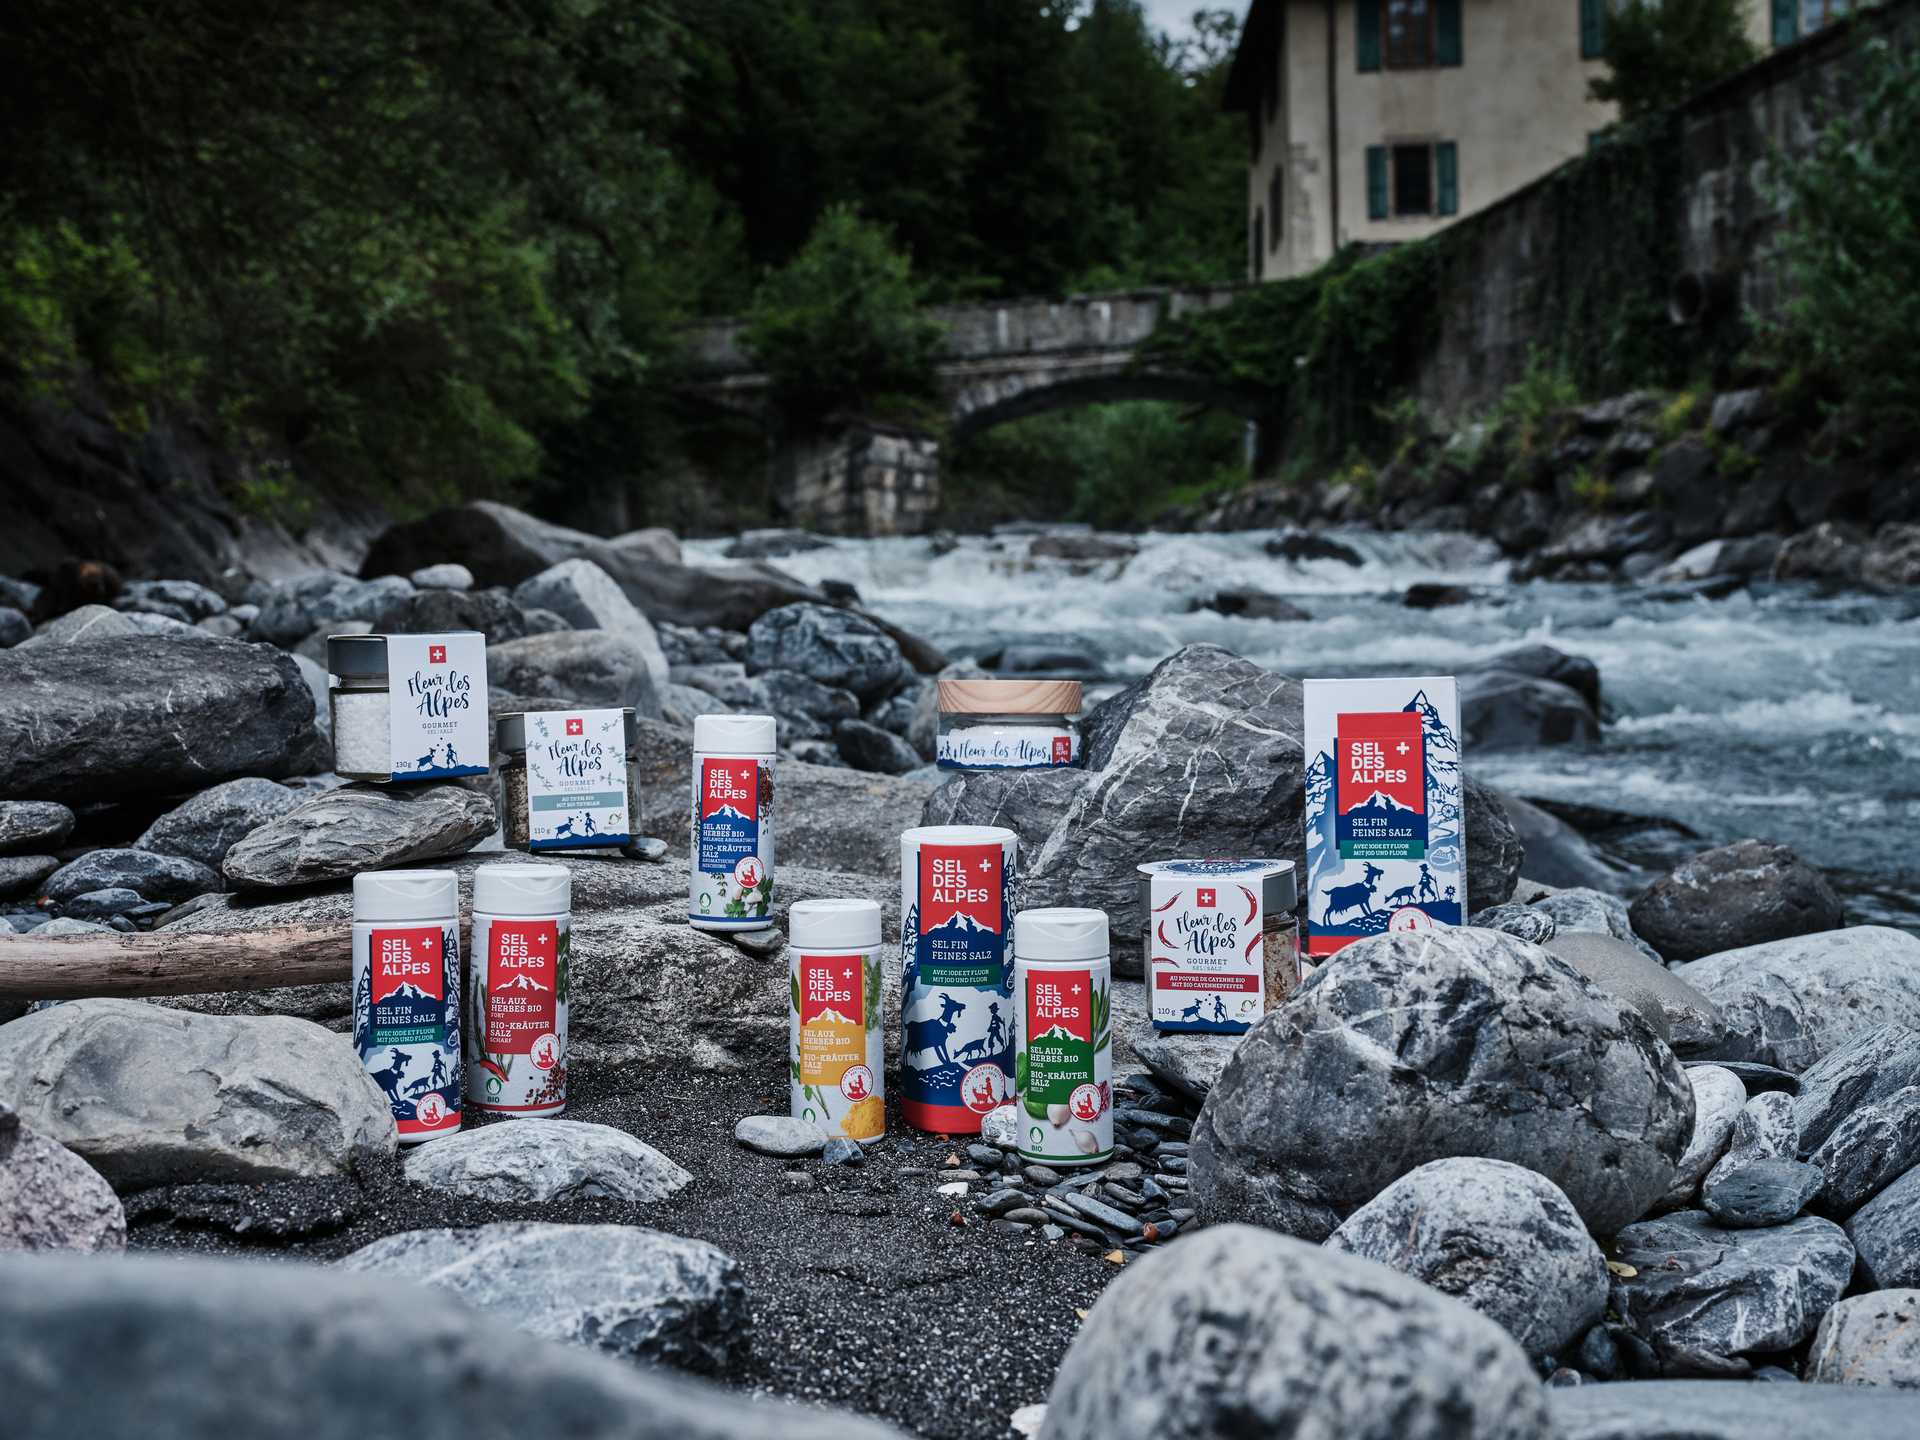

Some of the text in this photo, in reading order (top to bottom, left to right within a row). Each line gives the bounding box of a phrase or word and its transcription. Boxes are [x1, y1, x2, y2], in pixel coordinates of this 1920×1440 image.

[408, 671, 470, 696] Fleur des
[416, 689, 469, 717] Alpes
[548, 739, 602, 760] Fleur des
[959, 739, 1047, 762] Fleur des Alpes
[1351, 743, 1384, 755] SEL
[556, 754, 601, 777] Alpes
[1351, 757, 1384, 769] DES
[711, 769, 732, 779] SEL
[1351, 770, 1407, 783] ALPES
[710, 779, 732, 788] DES
[710, 789, 747, 799] ALPES
[1353, 818, 1387, 826] SEL FIN
[1353, 828, 1412, 837] FEINES SALZ
[703, 844, 752, 852] BIO-KRÄUTER
[933, 859, 966, 873] SEL
[933, 874, 967, 888] DES
[932, 889, 988, 902] ALPES
[1176, 911, 1237, 934] Fleur des
[501, 934, 528, 944] SEL
[1184, 929, 1235, 955] Alpes
[382, 939, 411, 951] SEL
[932, 940, 968, 949] SEL FIN
[501, 945, 528, 956] DES
[932, 951, 991, 960] FEINES SALZ
[382, 951, 412, 963] DES
[500, 957, 545, 967] ALPES
[382, 963, 430, 975] ALPES
[809, 969, 833, 979] SEL
[809, 980, 834, 990] DES
[1036, 984, 1061, 995] SEL
[809, 991, 850, 1001] ALPES
[1036, 995, 1061, 1006] DES
[377, 1007, 392, 1015] SEL
[1036, 1007, 1079, 1018] ALPES
[413, 1014, 436, 1023] SALZ
[491, 1021, 549, 1029] BIO-KRÄUTER
[490, 1029, 511, 1037] SALZ
[804, 1037, 834, 1045] HERBES
[1030, 1046, 1043, 1054] SEL
[804, 1053, 859, 1061] BIO-KRÄUTER
[1030, 1054, 1062, 1062] HERBES
[1031, 1071, 1088, 1079] BIO-KRÄUTER
[1031, 1079, 1049, 1087] SALZ
